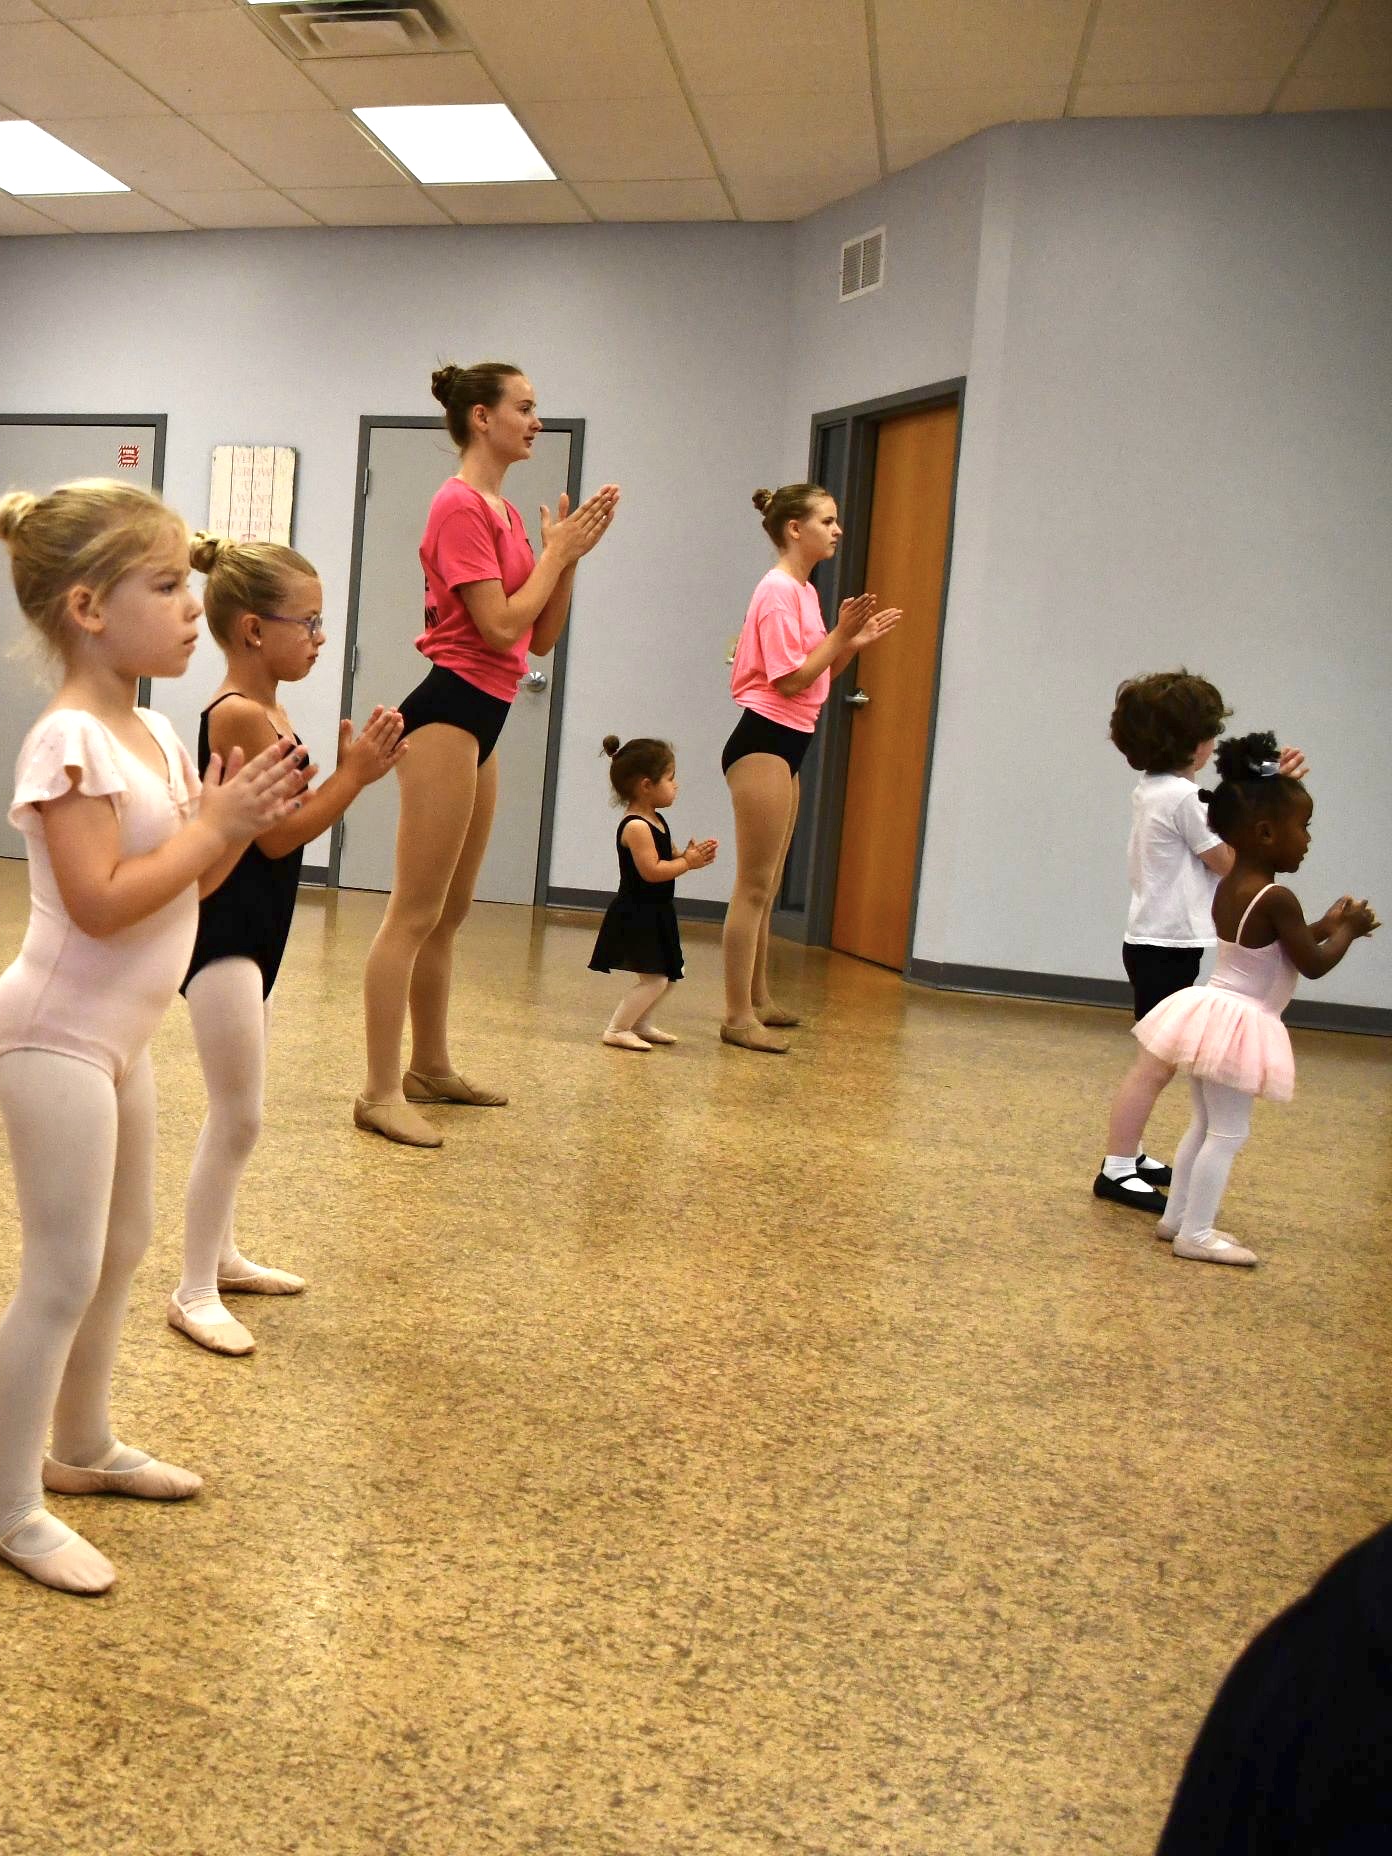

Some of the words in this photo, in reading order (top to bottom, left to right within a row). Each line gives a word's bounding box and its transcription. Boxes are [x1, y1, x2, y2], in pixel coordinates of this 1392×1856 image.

[234, 467, 273, 477] GROW
[244, 481, 261, 490] UP
[236, 494, 272, 504] WANT
